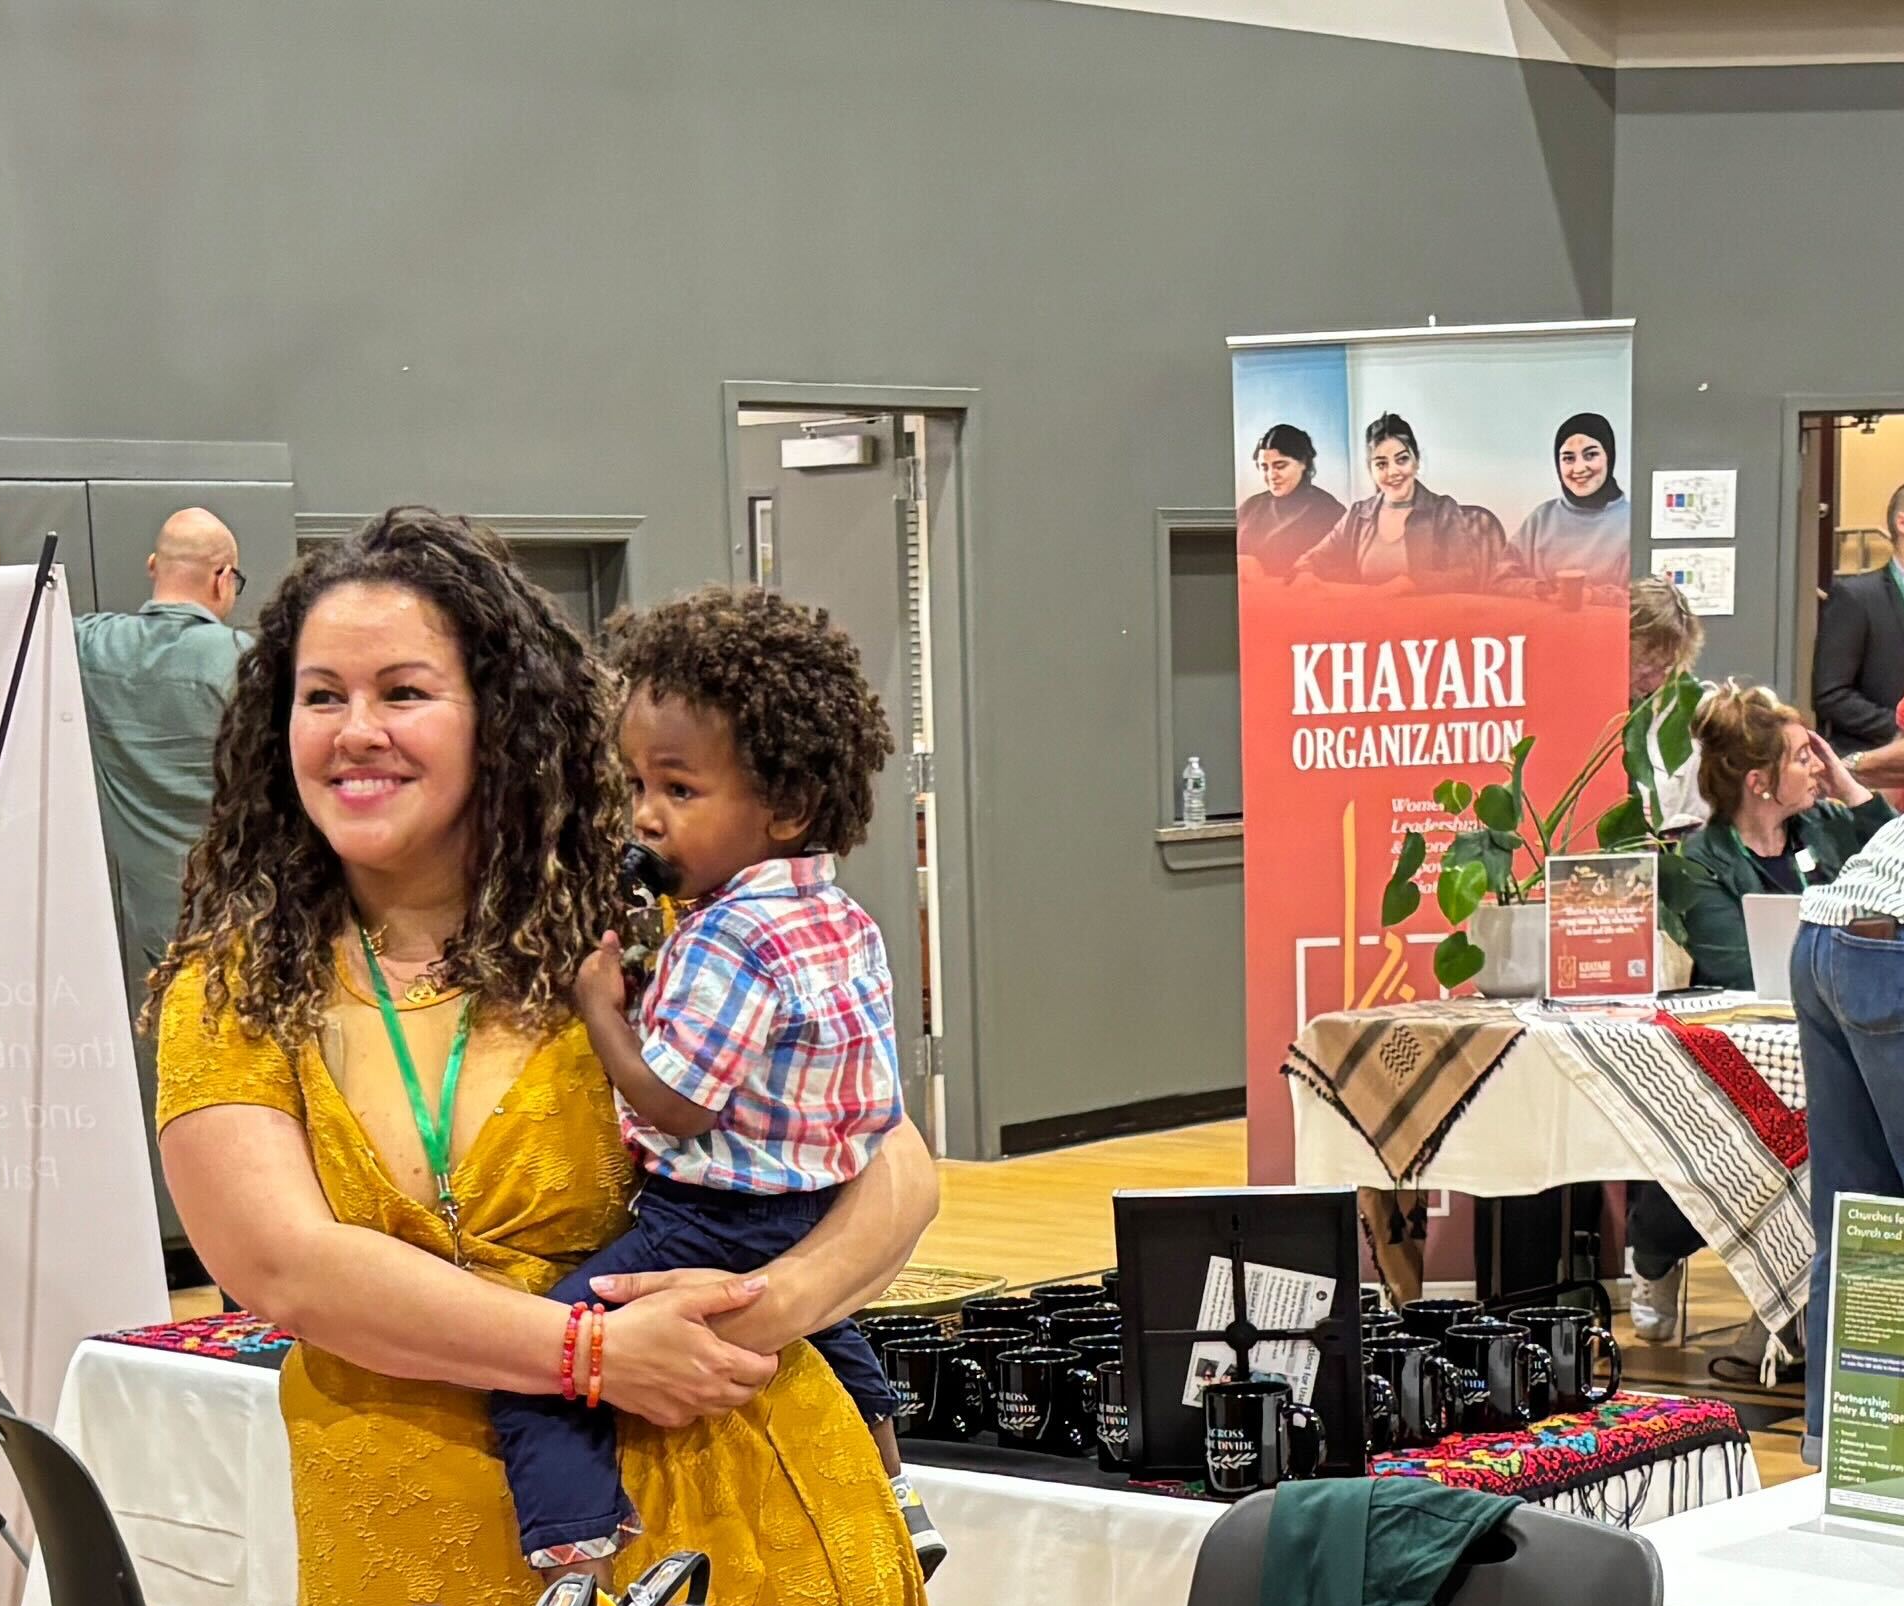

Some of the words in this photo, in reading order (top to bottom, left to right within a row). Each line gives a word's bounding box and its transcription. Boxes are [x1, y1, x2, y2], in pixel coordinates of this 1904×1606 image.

[1291, 634, 1527, 716] KHAYARI
[1291, 719, 1524, 771] ORGANIZATION
[1848, 1209, 1894, 1225] Churches
[1846, 1225, 1883, 1239] Church
[1883, 1229, 1903, 1241] and
[1833, 1391, 1891, 1409] Partnership:
[1832, 1403, 1858, 1418] Entry
